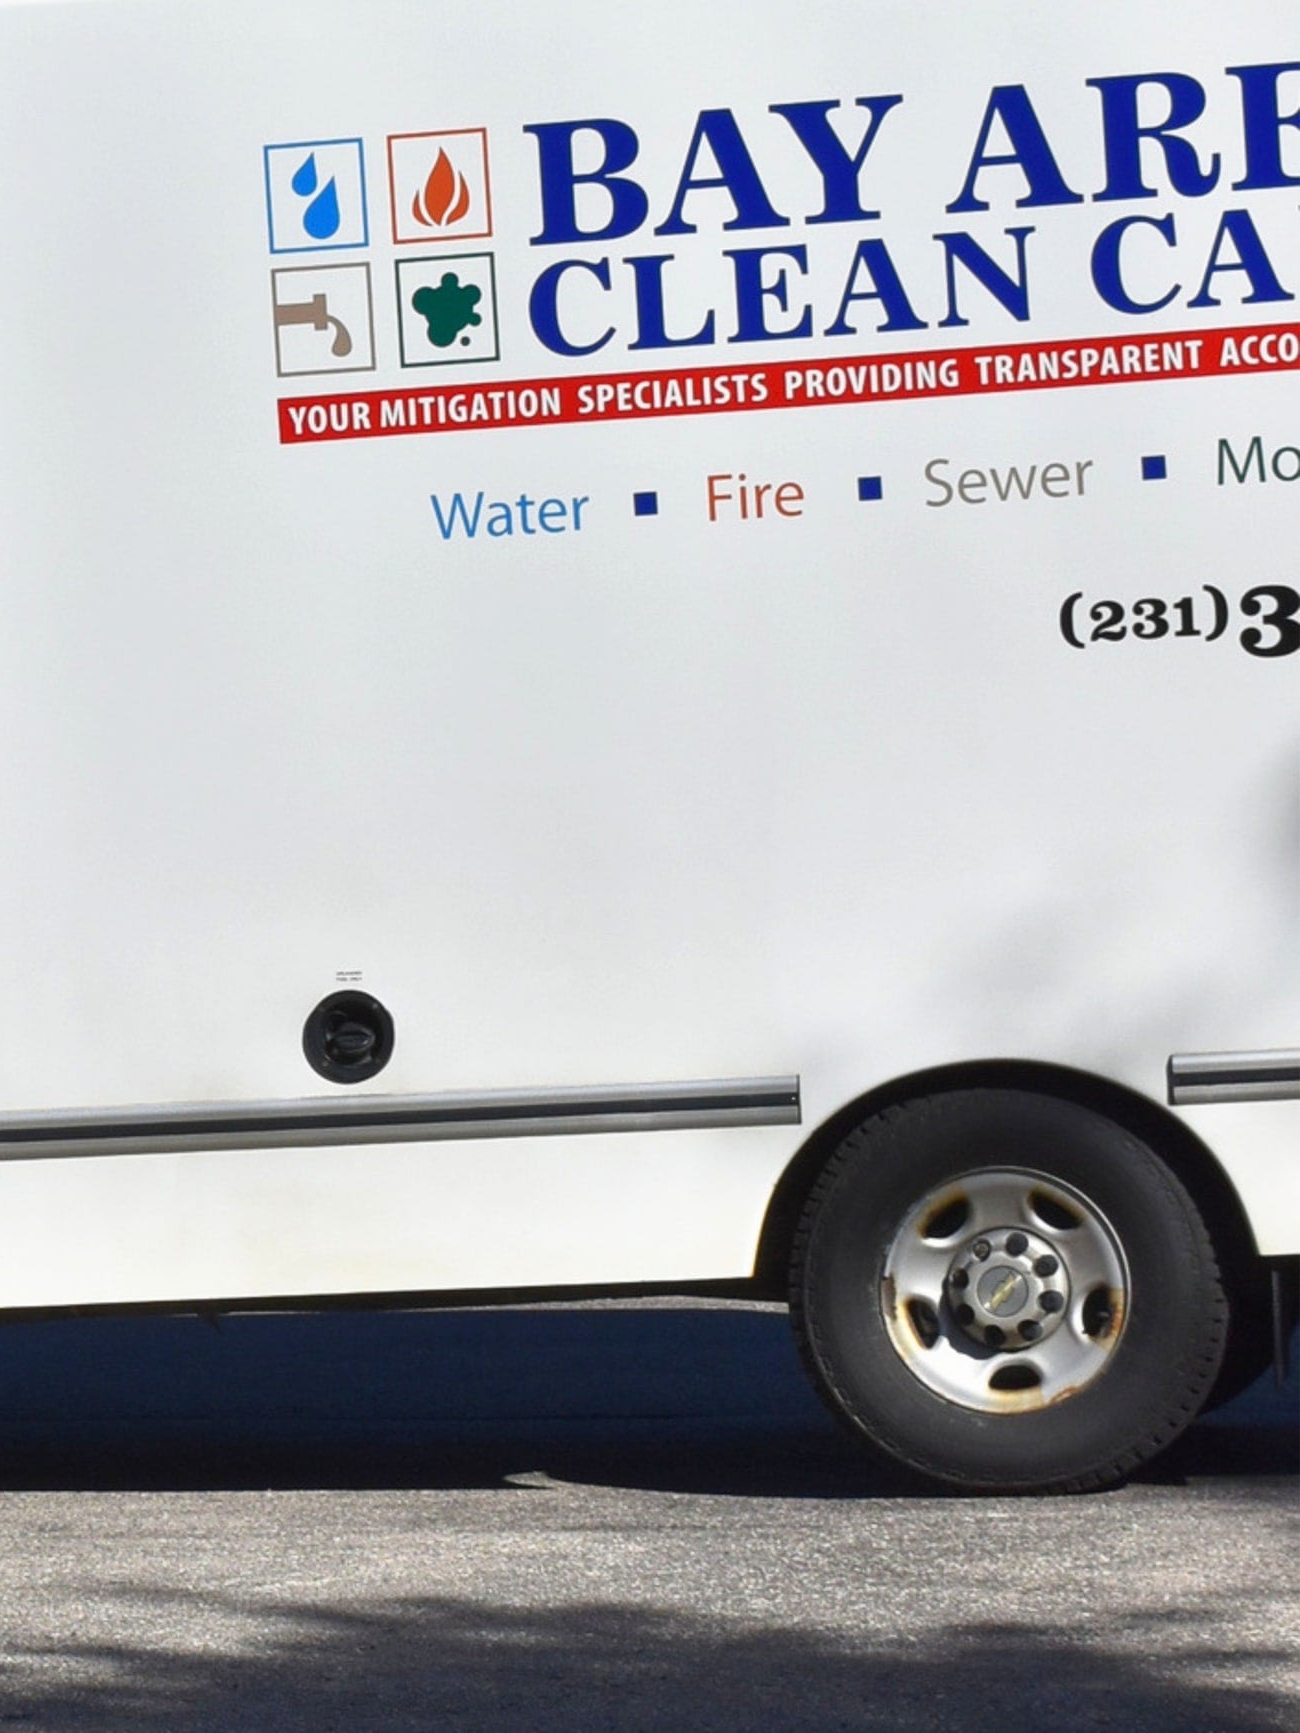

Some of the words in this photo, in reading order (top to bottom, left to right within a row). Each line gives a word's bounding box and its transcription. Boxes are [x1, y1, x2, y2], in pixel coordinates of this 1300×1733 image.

[523, 94, 903, 246] BAY
[946, 62, 1300, 213] ARE
[528, 226, 1036, 357] CLEAN
[1091, 208, 1300, 314] CA
[287, 402, 371, 435] YOUR
[380, 387, 561, 428] MITIGATION
[578, 373, 768, 414] SPECIALISTS
[784, 358, 959, 399] PROVIDING
[974, 340, 1203, 385] TRANSPARENT
[1220, 333, 1300, 367] ACCO
[431, 492, 590, 540] Water
[707, 475, 804, 521] Fire
[925, 459, 1093, 506] Sewer
[1218, 436, 1300, 485] Mo
